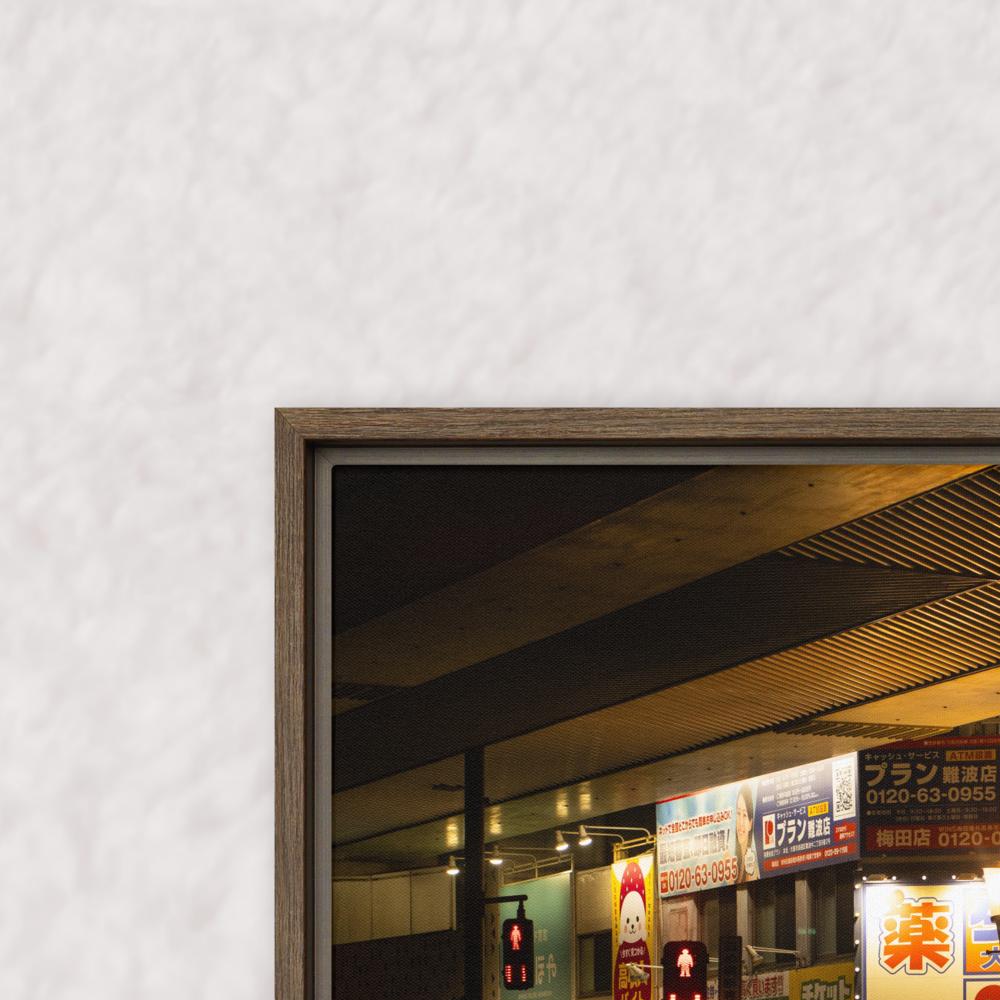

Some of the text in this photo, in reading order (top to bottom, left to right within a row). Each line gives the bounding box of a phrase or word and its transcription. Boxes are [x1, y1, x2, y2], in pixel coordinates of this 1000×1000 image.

[866, 786, 997, 804] 0120-63-0955
[876, 828, 931, 848] 梅田店
[669, 857, 738, 892] 0120-63-0955
[883, 901, 951, 971] 薬
